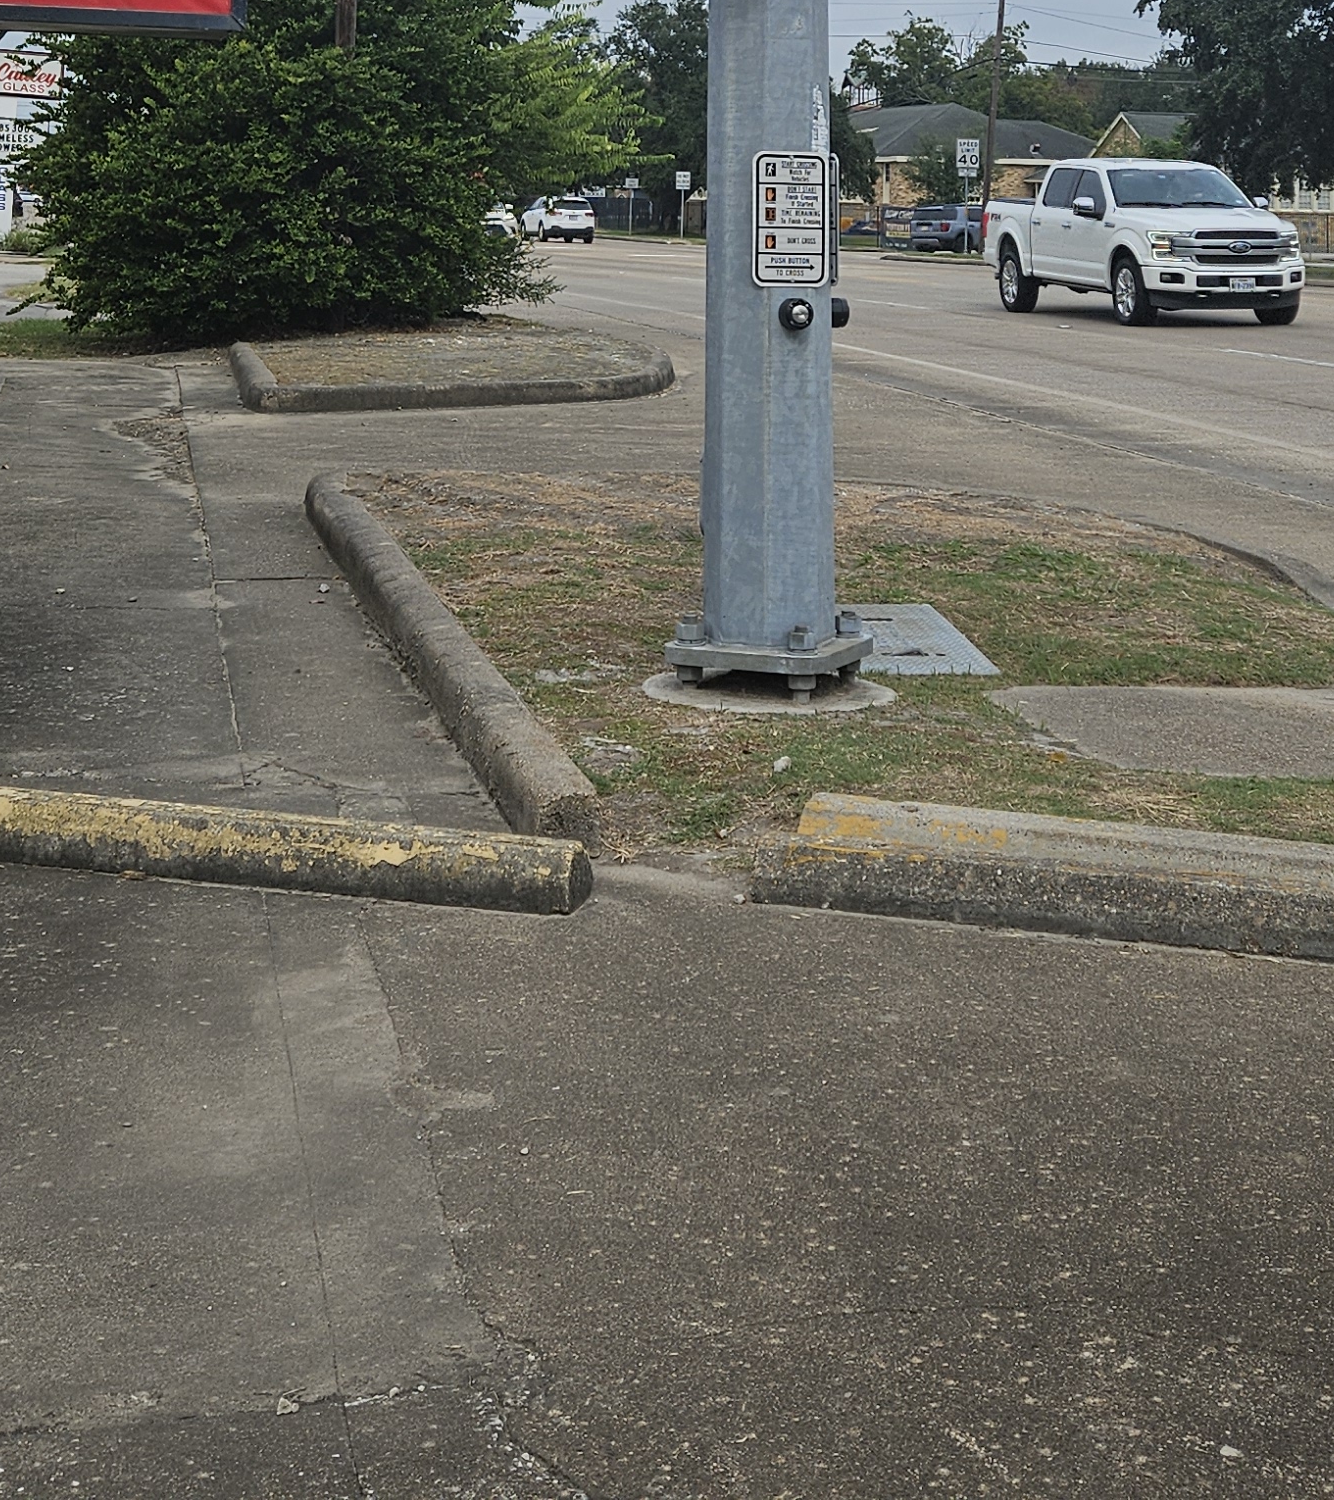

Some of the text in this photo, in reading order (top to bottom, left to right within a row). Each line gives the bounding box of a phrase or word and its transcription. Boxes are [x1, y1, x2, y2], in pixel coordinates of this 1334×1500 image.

[3, 82, 45, 93] GLASS
[958, 153, 979, 165] 40
[788, 257, 810, 265] BUTTON
